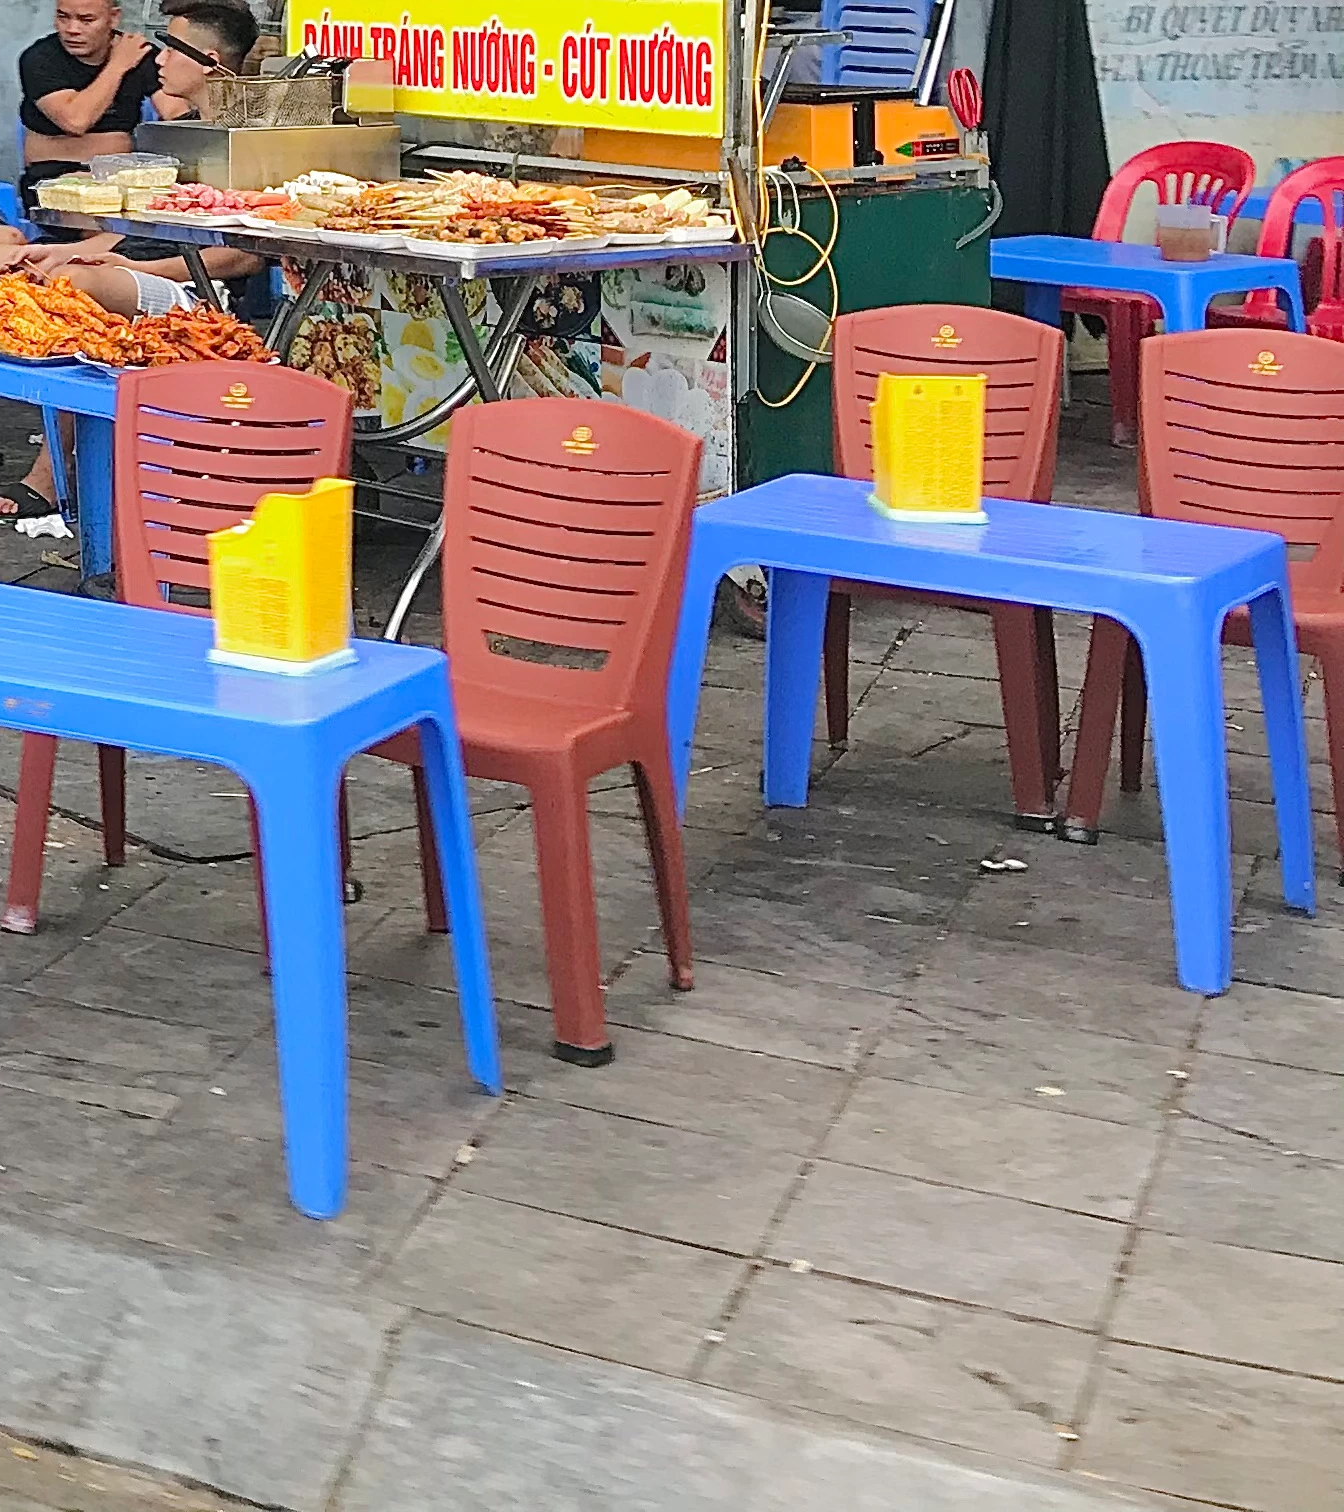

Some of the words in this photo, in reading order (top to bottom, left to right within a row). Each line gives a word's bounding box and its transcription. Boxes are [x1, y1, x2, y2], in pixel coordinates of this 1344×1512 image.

[370, 16, 445, 89] TRÁNG
[453, 19, 536, 95] NƯỚNG
[562, 23, 611, 99] CÚT
[619, 26, 713, 107] NƯỚNG
